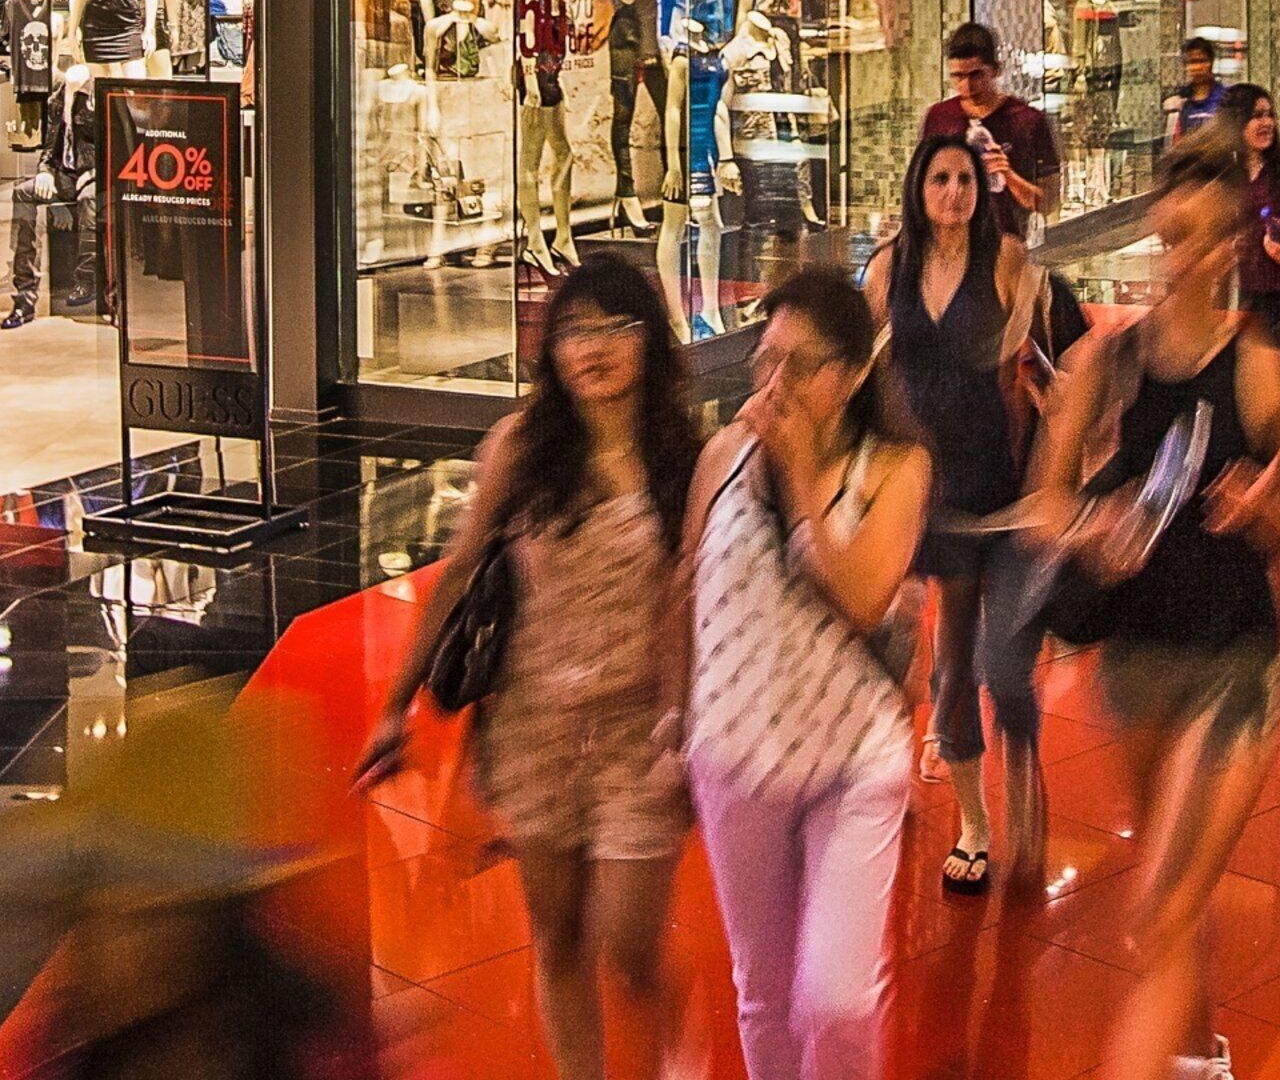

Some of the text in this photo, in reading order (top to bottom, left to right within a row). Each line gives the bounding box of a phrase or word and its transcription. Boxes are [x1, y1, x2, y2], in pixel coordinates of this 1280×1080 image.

[144, 129, 187, 139] ADDITIONAL
[117, 142, 212, 191] 40%
[183, 176, 213, 192] OFF
[121, 193, 153, 204] ALREADY
[153, 195, 185, 205] REDUCED
[186, 196, 211, 207] PRICES
[128, 377, 255, 426] GUESS
